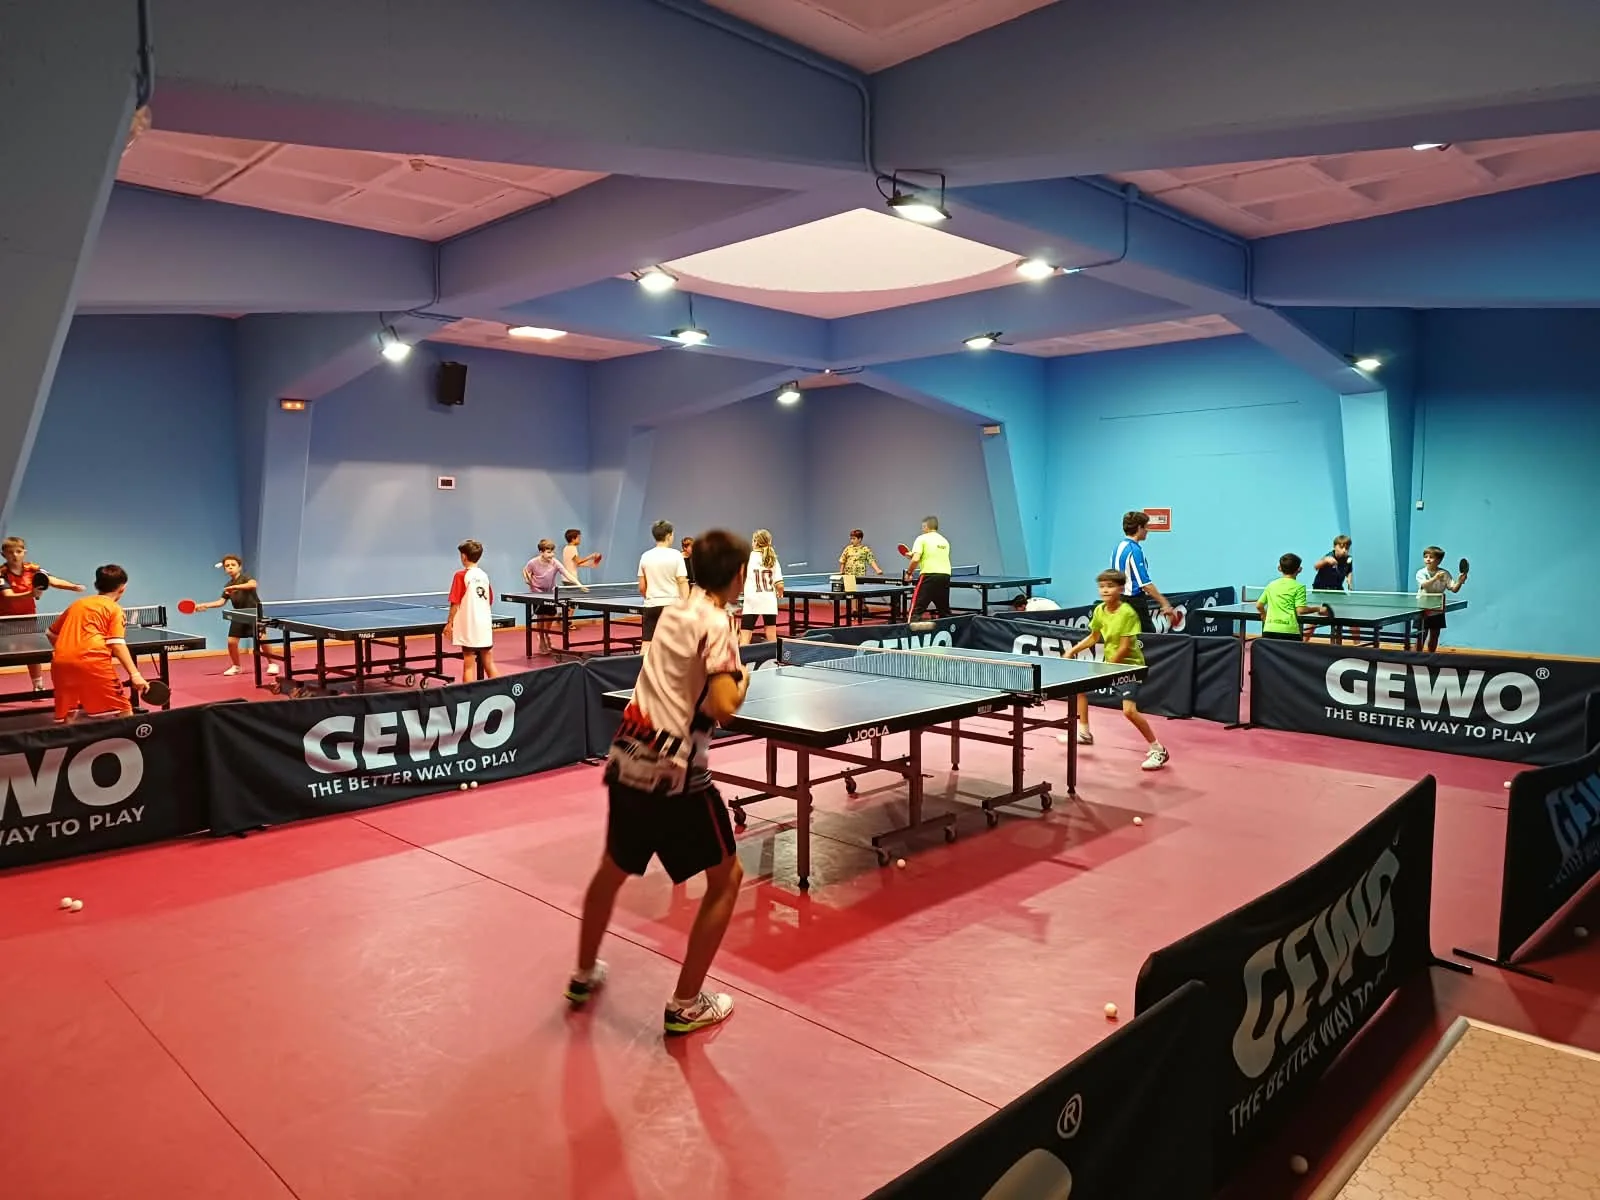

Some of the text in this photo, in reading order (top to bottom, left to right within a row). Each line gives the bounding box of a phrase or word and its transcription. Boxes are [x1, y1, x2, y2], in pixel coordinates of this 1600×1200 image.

[753, 569, 774, 593] 10
[1013, 635, 1105, 662] GEW
[1325, 657, 1541, 725] GEWO
[303, 694, 516, 774] GEWO
[855, 725, 890, 742] JOOLA
[1325, 706, 1537, 744] THE BETTER WAY TO PLAY
[308, 749, 518, 798] THE BETTER WAY TO PLAY
[0, 805, 145, 846] AY TO PLAY
[1232, 848, 1400, 1078] GEWO
[1229, 1083, 1266, 1136] THE
[1265, 1031, 1319, 1101] BETTER
[1319, 996, 1354, 1047] WAY
